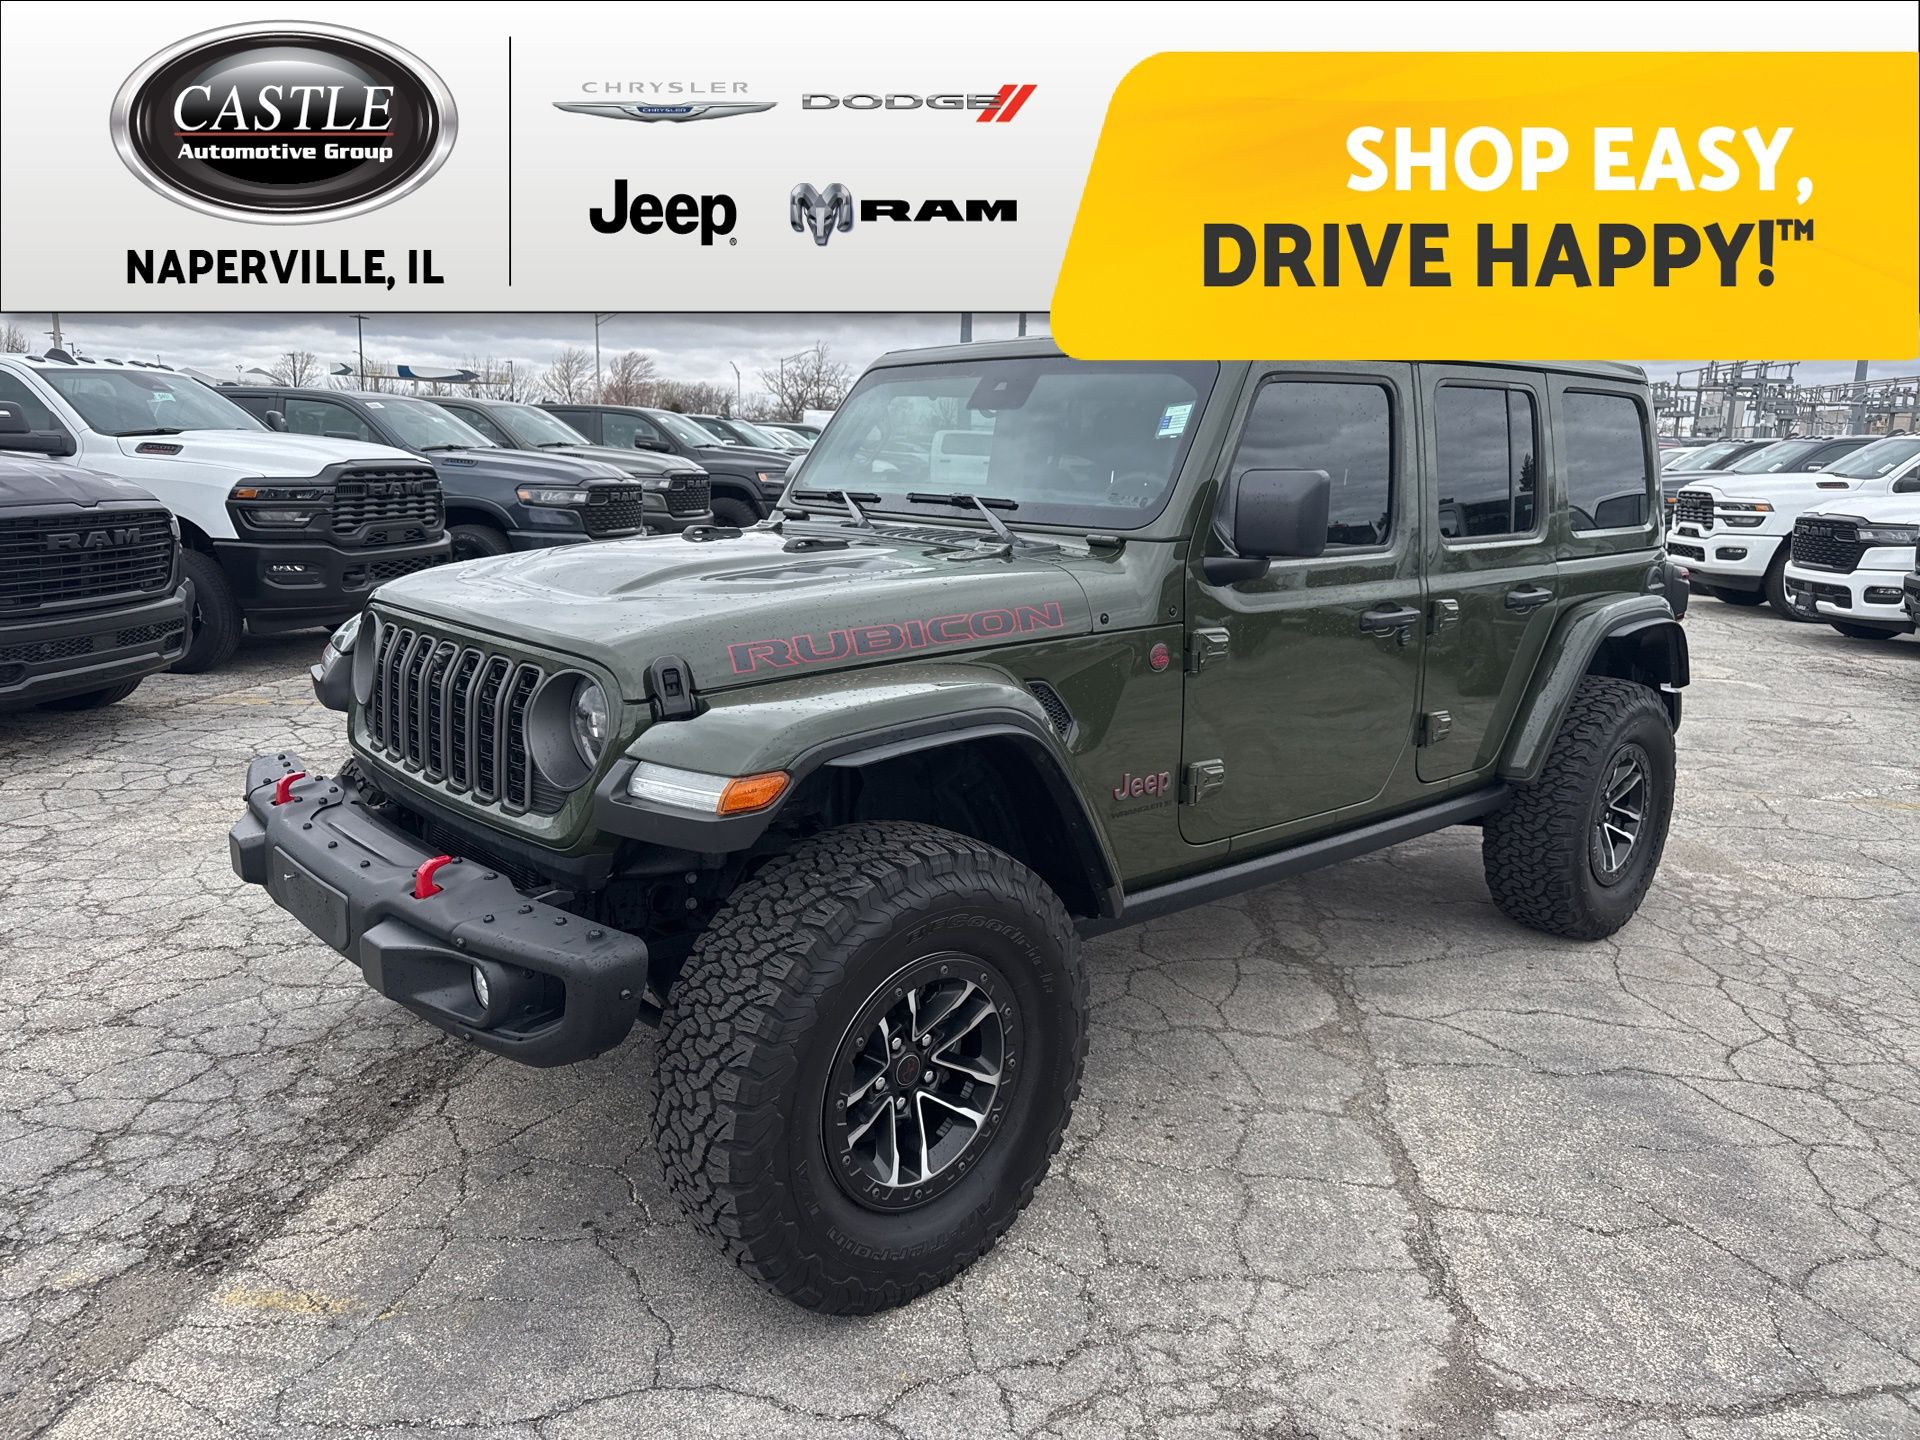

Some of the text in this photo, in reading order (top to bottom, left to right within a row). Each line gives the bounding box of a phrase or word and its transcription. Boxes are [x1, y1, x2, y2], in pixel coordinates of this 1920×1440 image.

[367, 481, 421, 496] RAM
[610, 491, 639, 501] RAM
[47, 528, 140, 551] RAM
[1803, 525, 1833, 537] RAM
[728, 602, 1064, 674] RUBICON
[1112, 771, 1171, 801] Jeep
